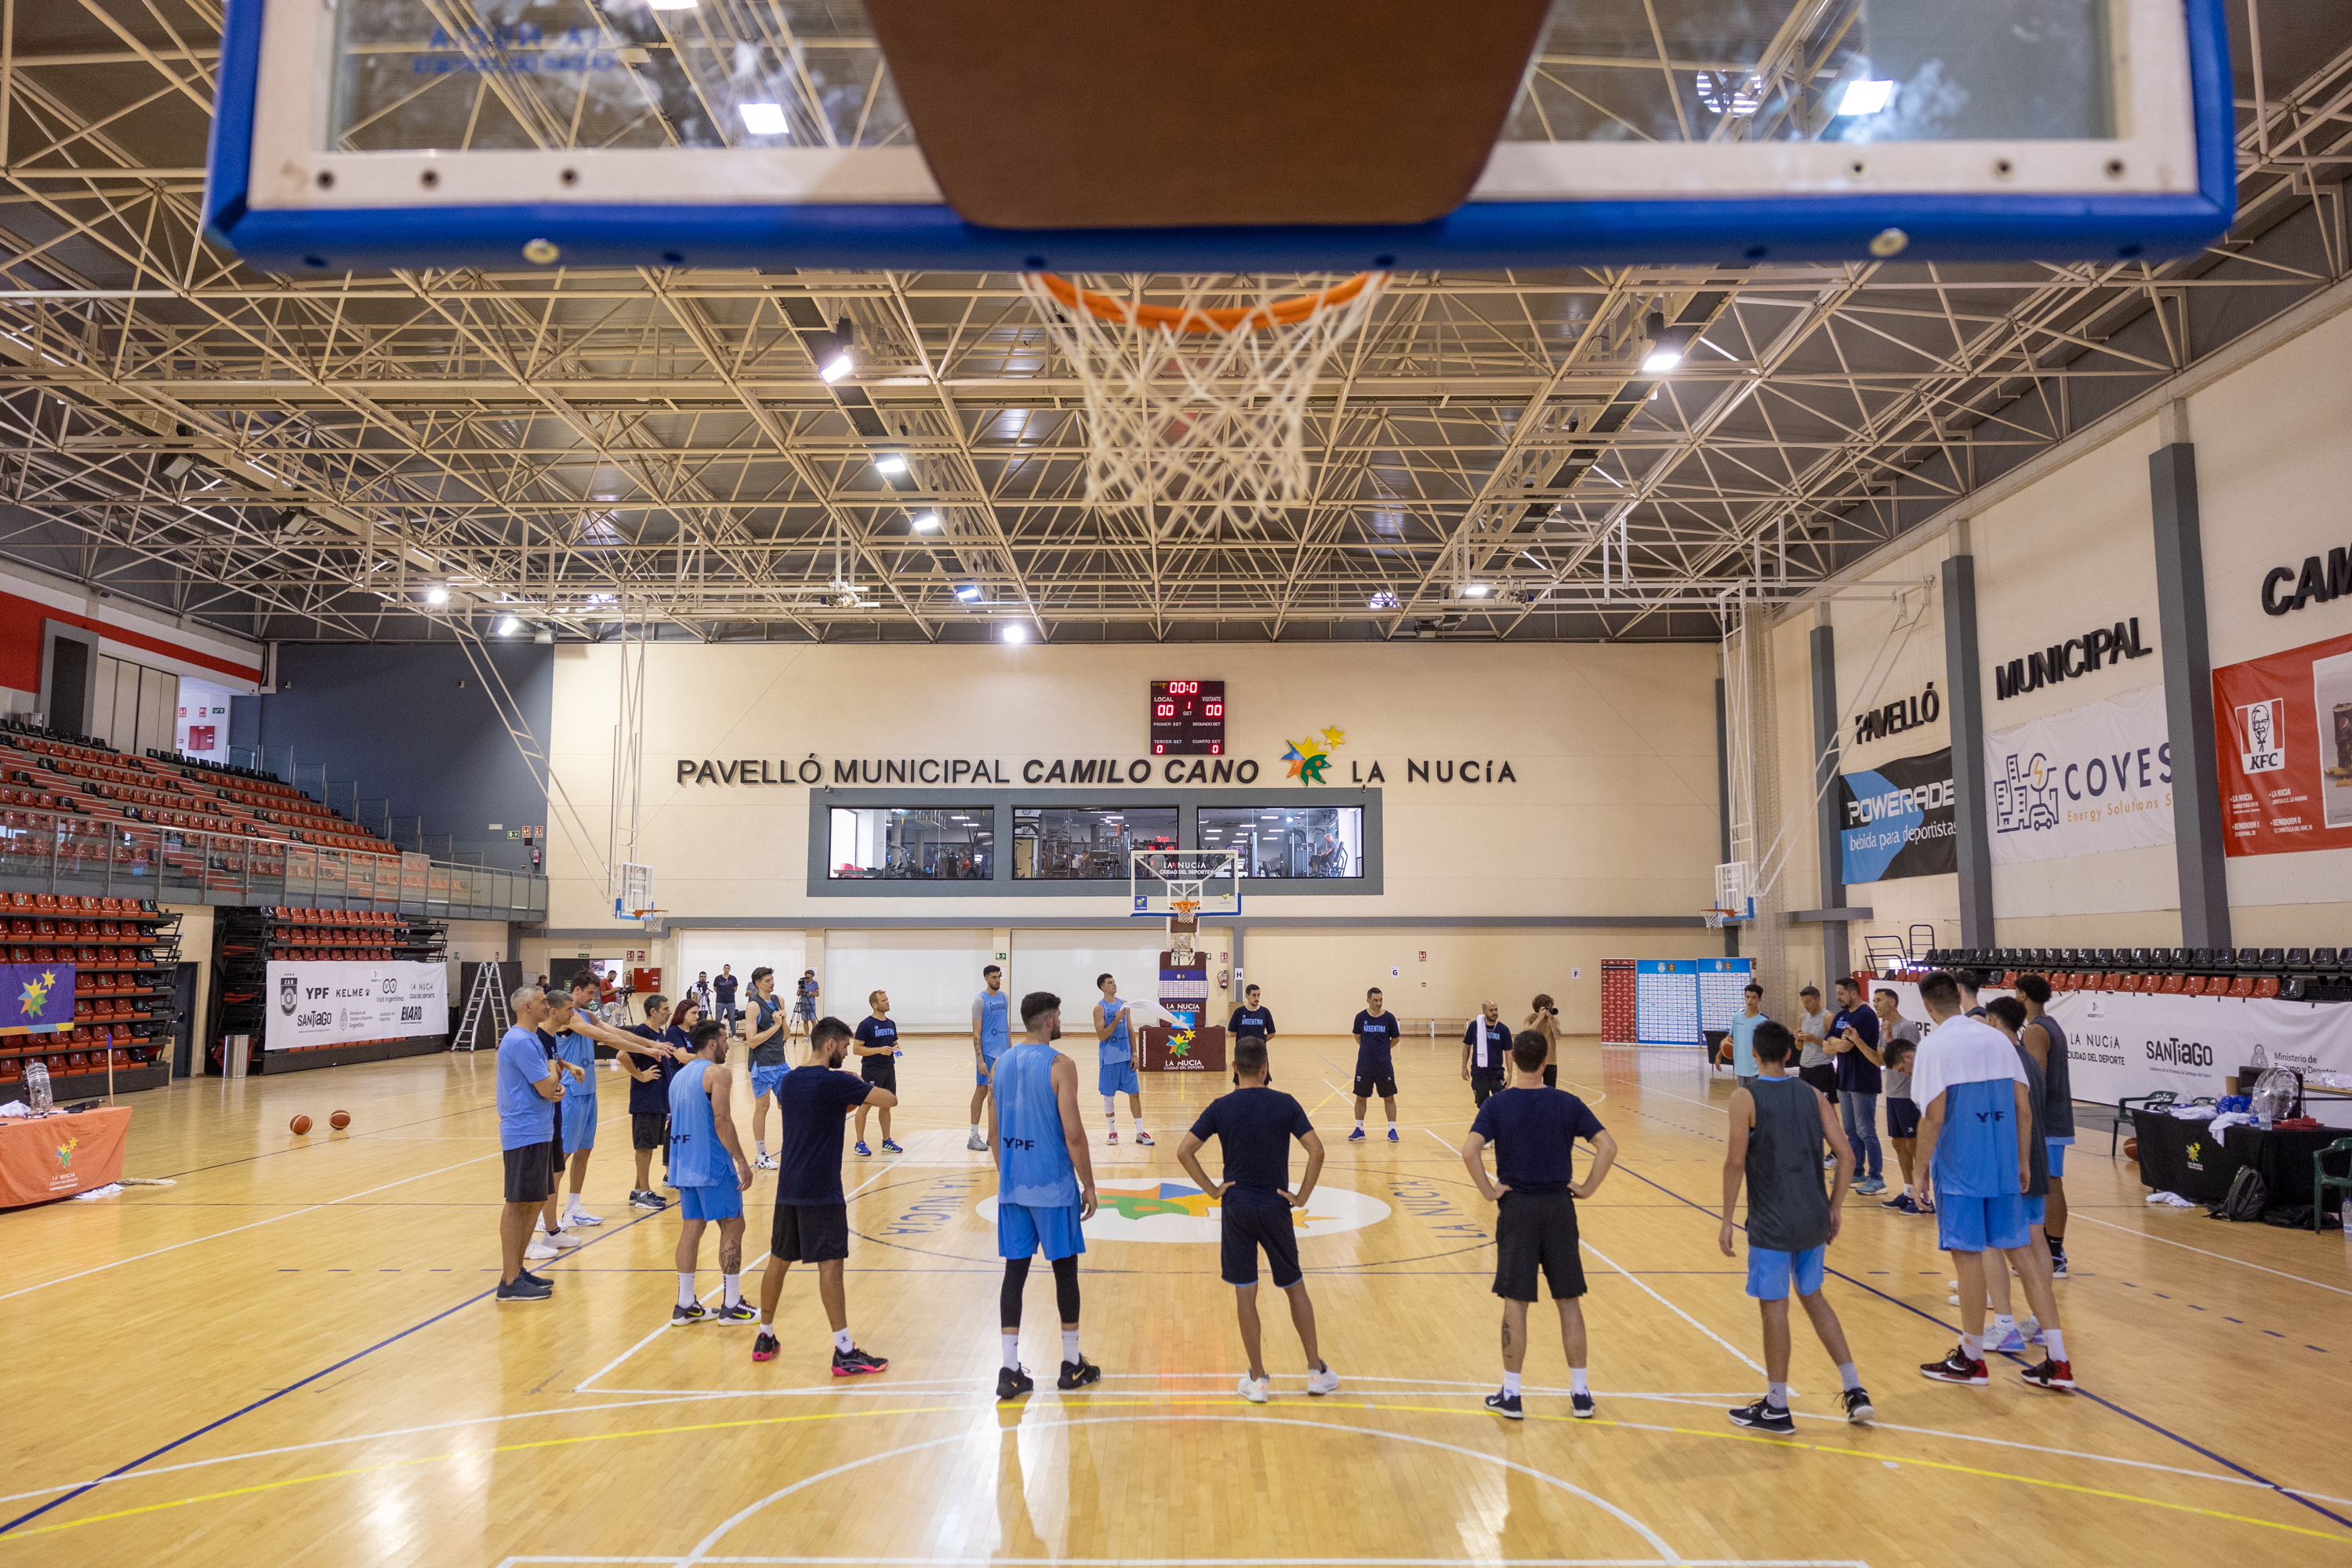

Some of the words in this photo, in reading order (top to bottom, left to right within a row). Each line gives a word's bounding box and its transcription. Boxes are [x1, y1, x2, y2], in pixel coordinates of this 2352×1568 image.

[1995, 617, 2153, 700] MUNICIPAL
[1157, 704, 1174, 716] 00
[1206, 704, 1221, 716] 00
[1855, 681, 1940, 744] PAVELLÓ
[1156, 745, 1163, 753] 0
[1212, 745, 1218, 753] 0
[2249, 753, 2278, 770] KFC
[677, 753, 821, 784] PAVELLÓ
[835, 759, 1010, 784] MUNICIPAL
[1022, 759, 1151, 784] CAMILO
[1164, 759, 1258, 784] CANO
[1352, 760, 1385, 782] LA
[2064, 742, 2172, 801] COVES
[1847, 779, 1955, 825] POWERADE
[2067, 808, 2102, 823] Energy
[2107, 798, 2158, 817] Solutions
[2234, 822, 2256, 830] BENIDORM
[2273, 817, 2297, 826] BENIDORM
[1849, 834, 1877, 851] bebida
[1879, 829, 1900, 851] para
[1902, 820, 1956, 845] deportistas
[306, 988, 329, 1000] YPF
[336, 989, 363, 997] KELME
[1911, 1022, 1931, 1036] PF
[2071, 1033, 2081, 1045] LA
[2067, 1051, 2086, 1061] CIUDAD
[2087, 1054, 2098, 1062] DEL
[2099, 1054, 2125, 1065] DEPORTE
[2274, 1053, 2307, 1063] Ministerio
[2308, 1055, 2318, 1064] de
[1976, 1111, 2004, 1123] YF
[1003, 1138, 1034, 1151] YPF
[930, 1179, 981, 1190] LA
[1427, 1224, 1488, 1238] LA
